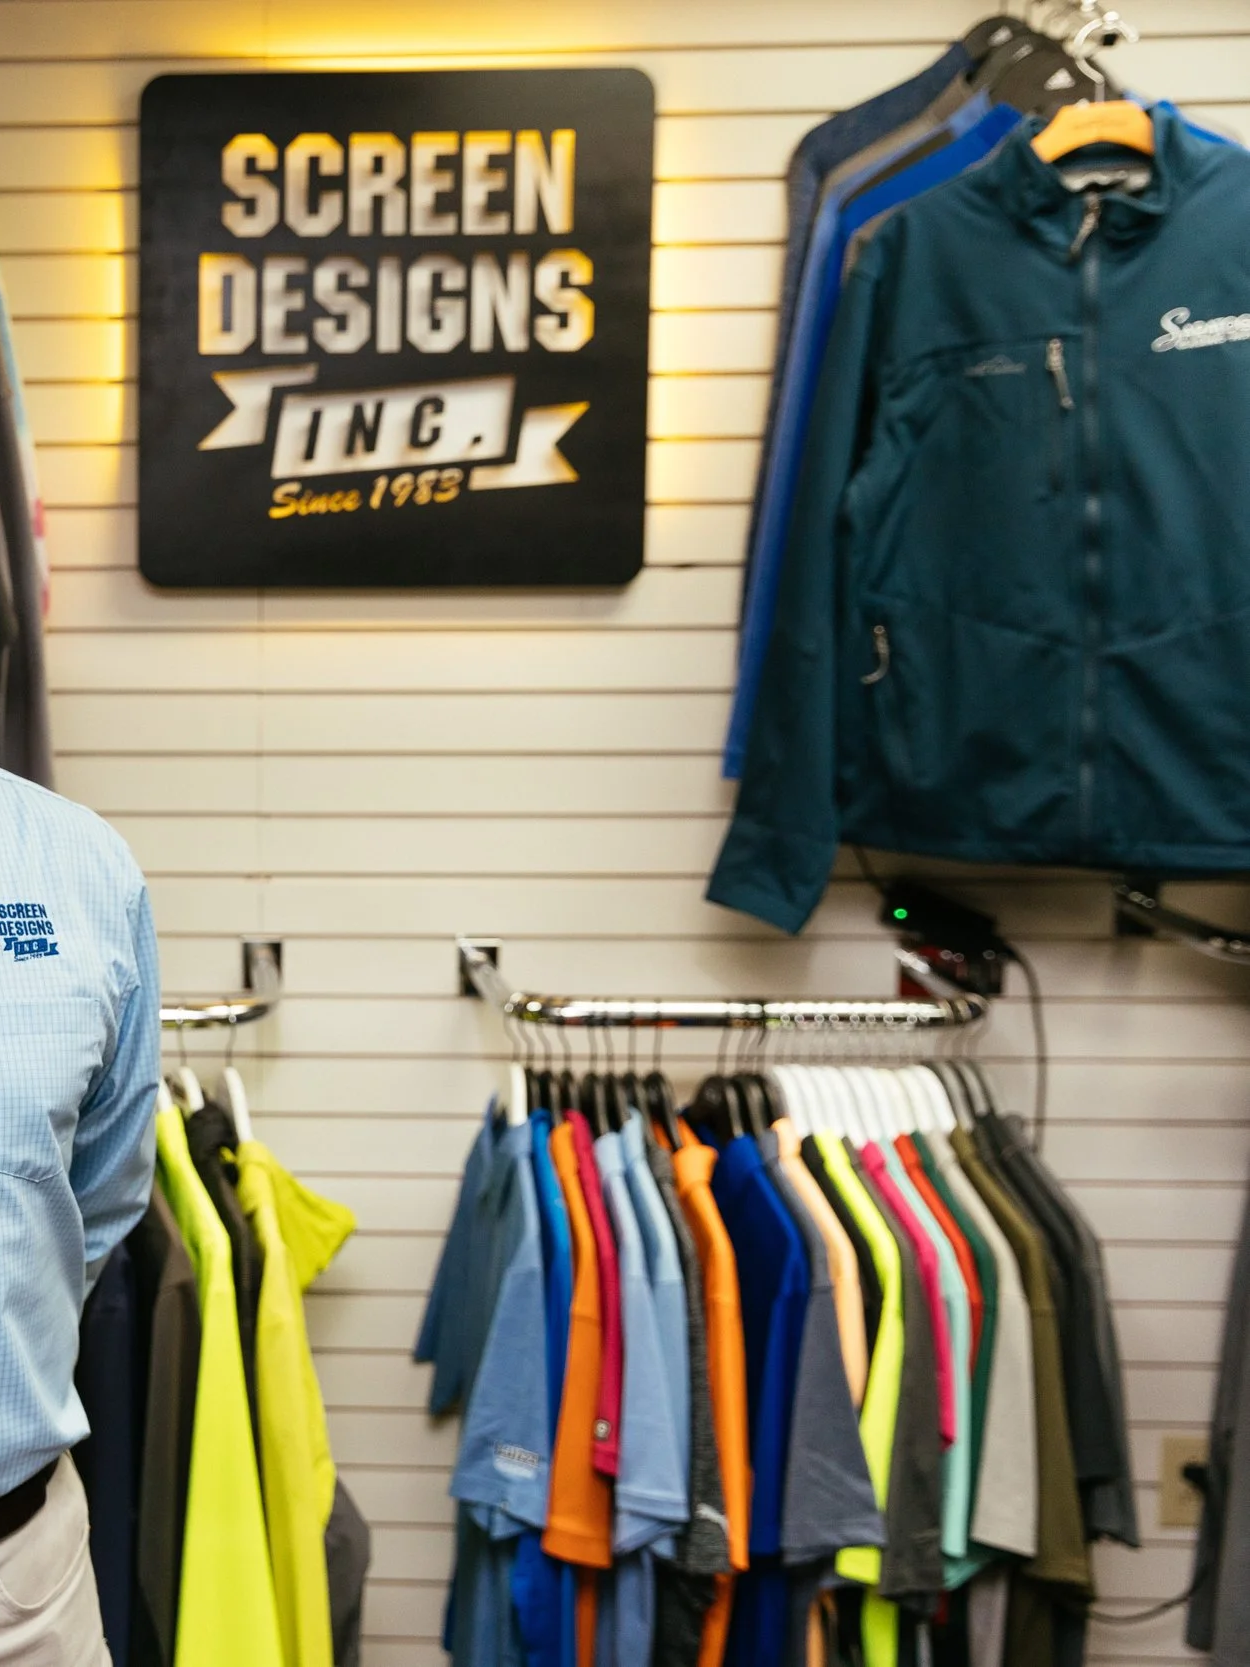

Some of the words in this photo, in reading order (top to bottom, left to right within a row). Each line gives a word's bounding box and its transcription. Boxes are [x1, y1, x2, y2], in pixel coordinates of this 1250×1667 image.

[221, 129, 577, 238] SCREEN
[198, 248, 596, 355] DESIGNS
[302, 394, 483, 463] INC.
[268, 481, 362, 519] Since
[369, 467, 465, 510] 1983
